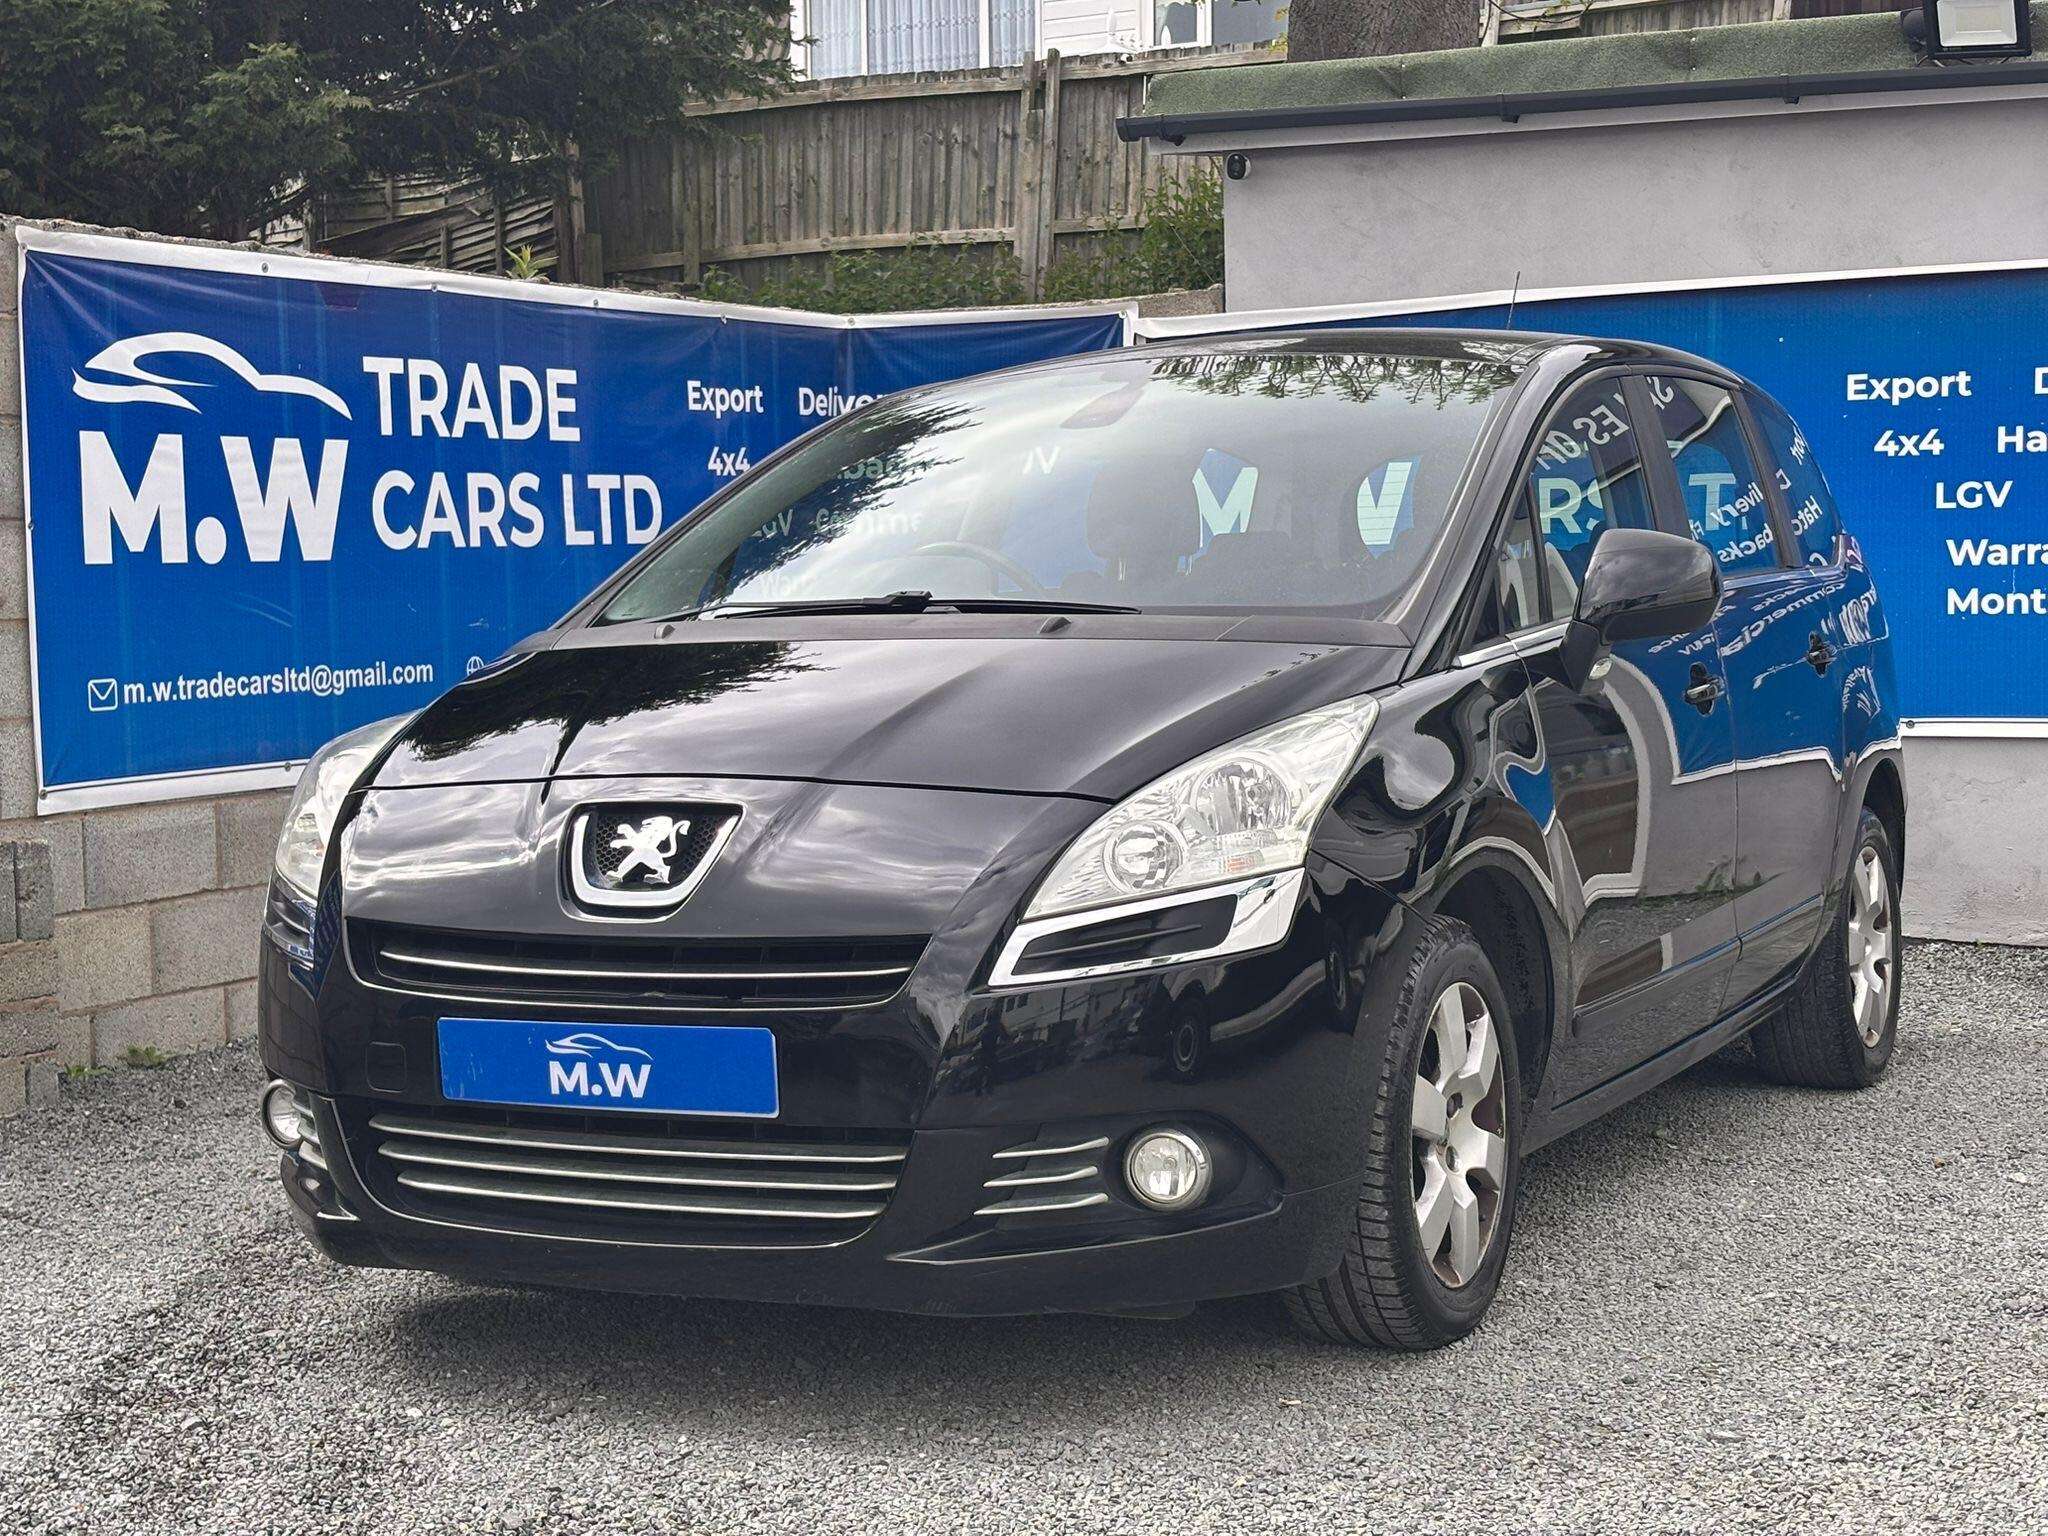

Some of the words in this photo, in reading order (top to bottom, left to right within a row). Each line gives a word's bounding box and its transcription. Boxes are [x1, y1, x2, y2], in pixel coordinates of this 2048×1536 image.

[363, 356, 580, 441] TRADE
[687, 380, 763, 418] Export
[1848, 371, 1971, 405] Export
[707, 446, 750, 477] 4x4
[1873, 429, 1945, 457] 4x4
[80, 431, 349, 564] M.W
[373, 470, 544, 549] CARS
[563, 474, 663, 547] LTD
[1935, 480, 2013, 509] LGV
[124, 662, 433, 704] m.w.tradecarsltd@gmail.com
[550, 1061, 651, 1098] M.W
